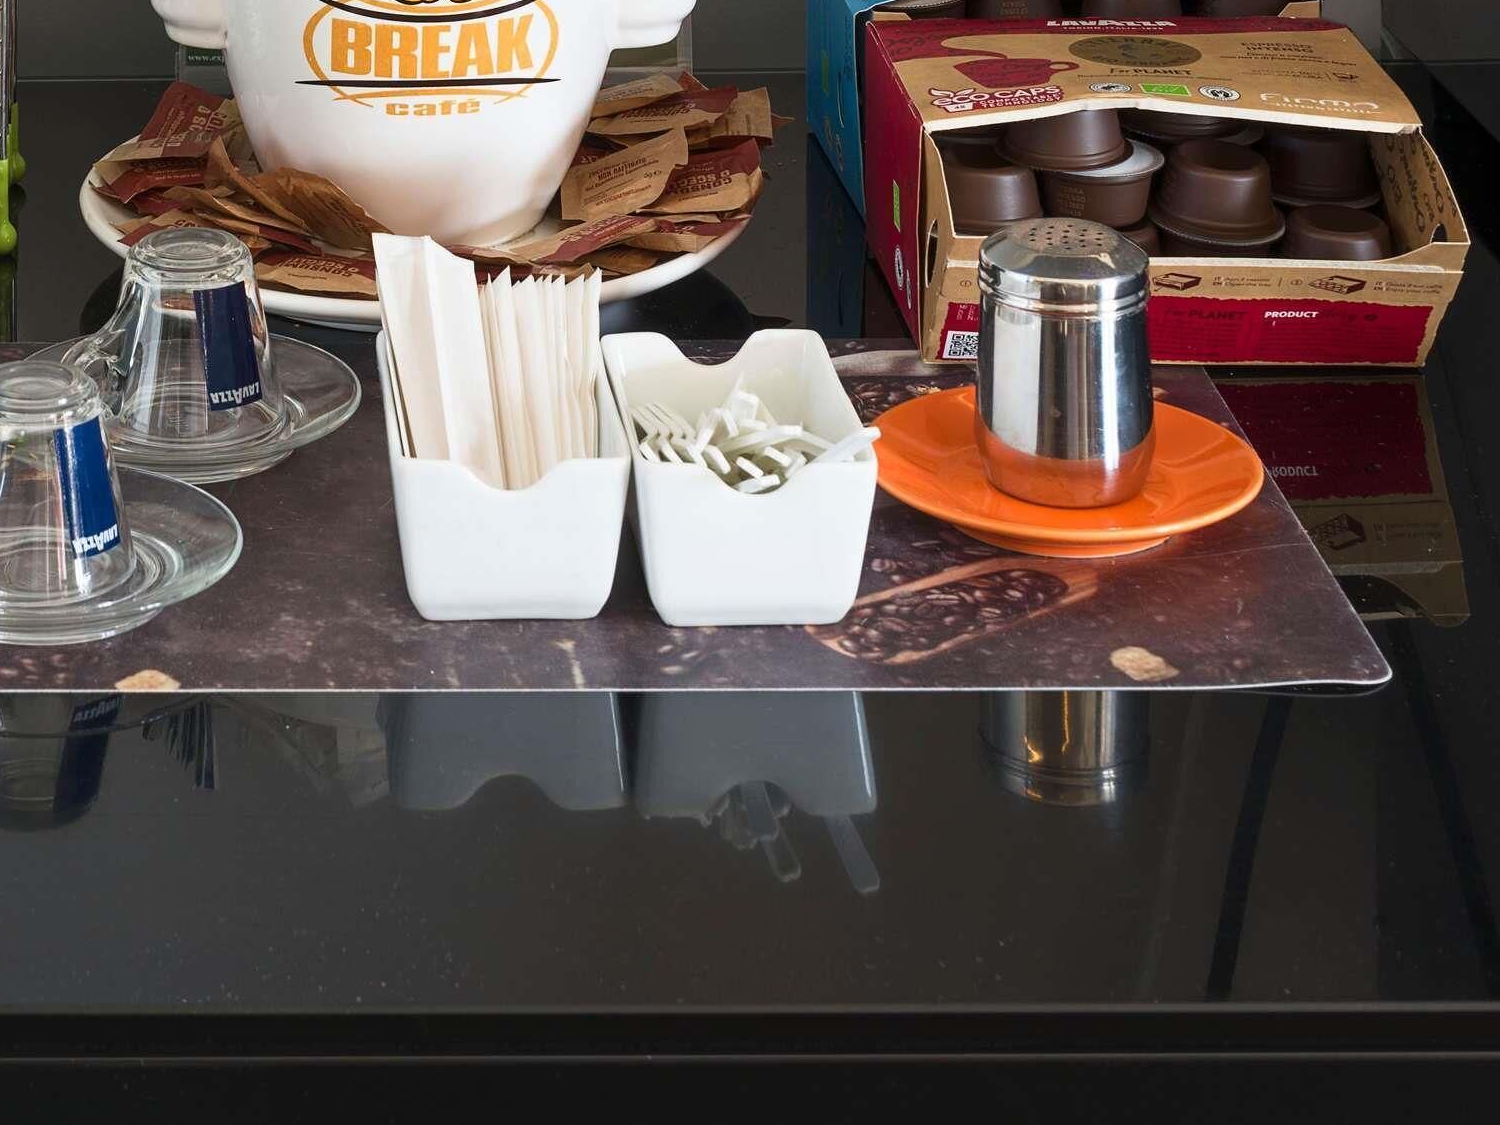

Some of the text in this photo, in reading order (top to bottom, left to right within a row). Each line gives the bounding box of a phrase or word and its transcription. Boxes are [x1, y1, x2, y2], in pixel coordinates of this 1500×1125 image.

[1046, 19, 1177, 27] LAVAZZA
[331, 13, 533, 80] BREAK
[994, 86, 1061, 98] CAPS
[385, 97, 482, 116] café
[675, 173, 717, 189] SCEG
[1264, 311, 1319, 319] PRODUCT
[209, 379, 261, 406] LAVAZZA
[72, 523, 118, 556] LAVAZZA
